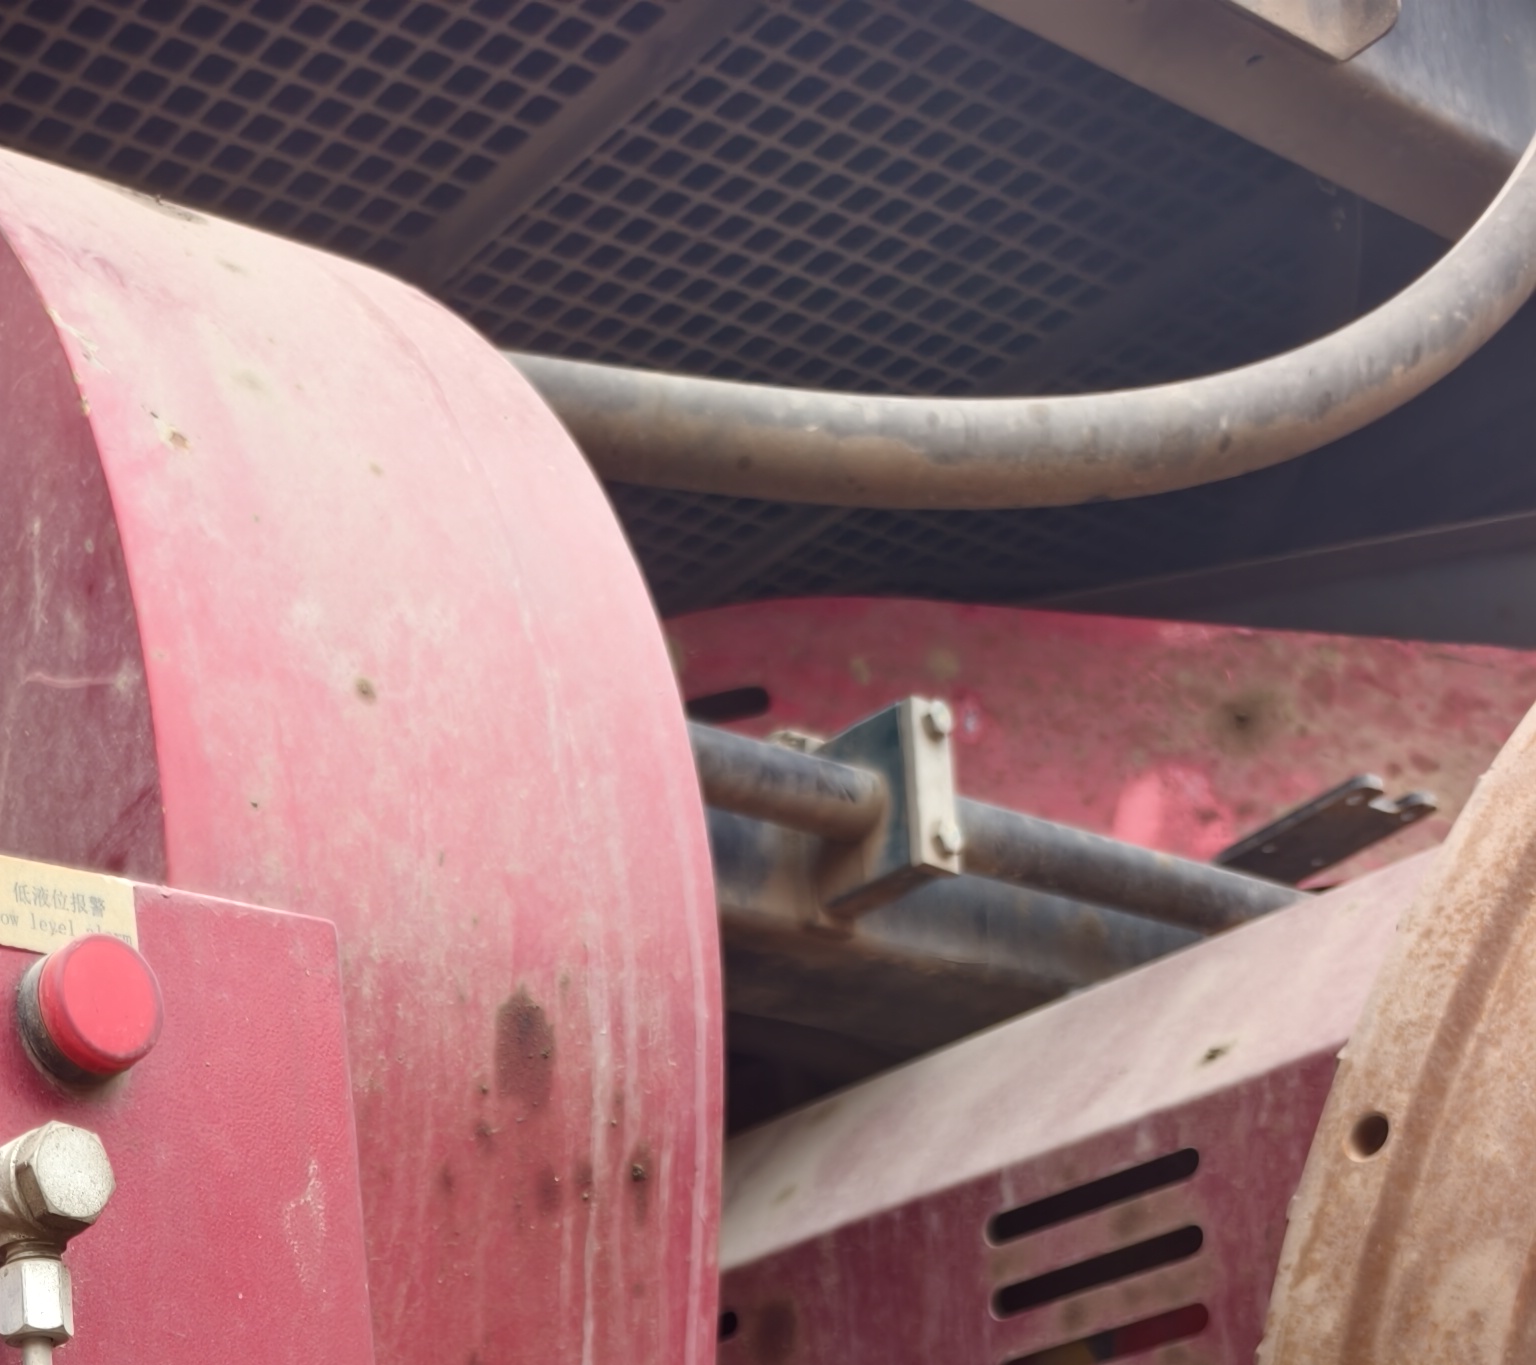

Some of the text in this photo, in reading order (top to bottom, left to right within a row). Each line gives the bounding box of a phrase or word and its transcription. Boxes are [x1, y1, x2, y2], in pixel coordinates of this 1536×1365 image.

[14, 882, 106, 918] 低液位报警
[31, 912, 75, 936] level
